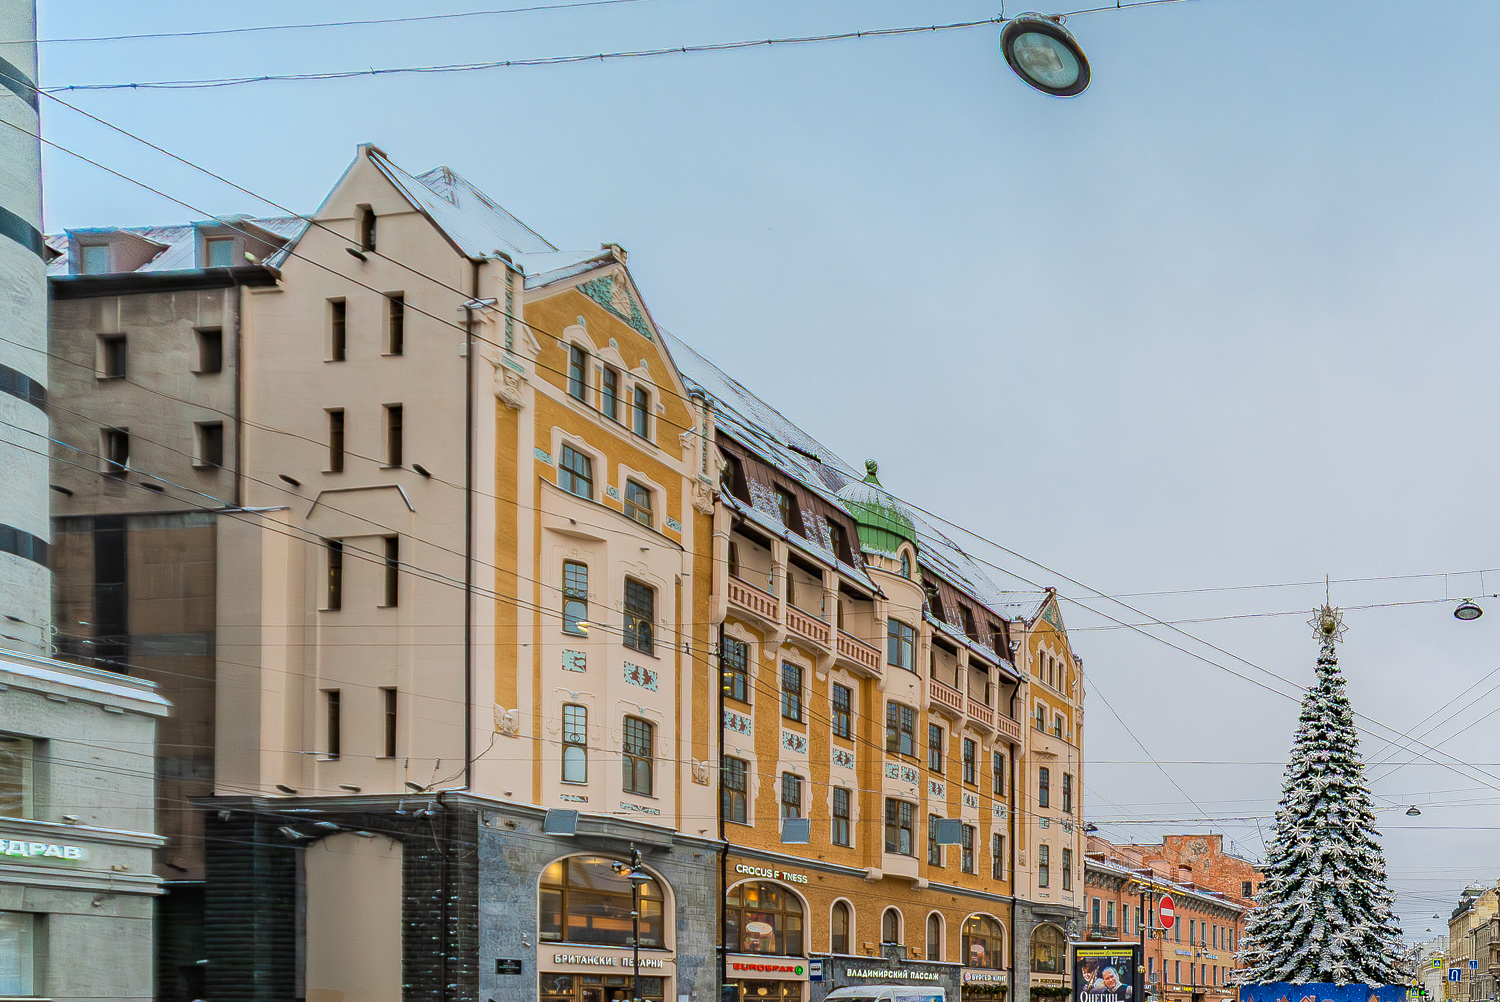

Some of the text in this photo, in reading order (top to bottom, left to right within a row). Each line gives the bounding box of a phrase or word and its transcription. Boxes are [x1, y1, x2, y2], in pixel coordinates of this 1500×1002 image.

[736, 864, 773, 878] CROCUS
[554, 954, 618, 967] БРИТАНСКИЕ
[733, 962, 795, 973] EUROSPAR
[847, 968, 939, 981] ВЛАДИМИРСКИЙ ПАССАЖ
